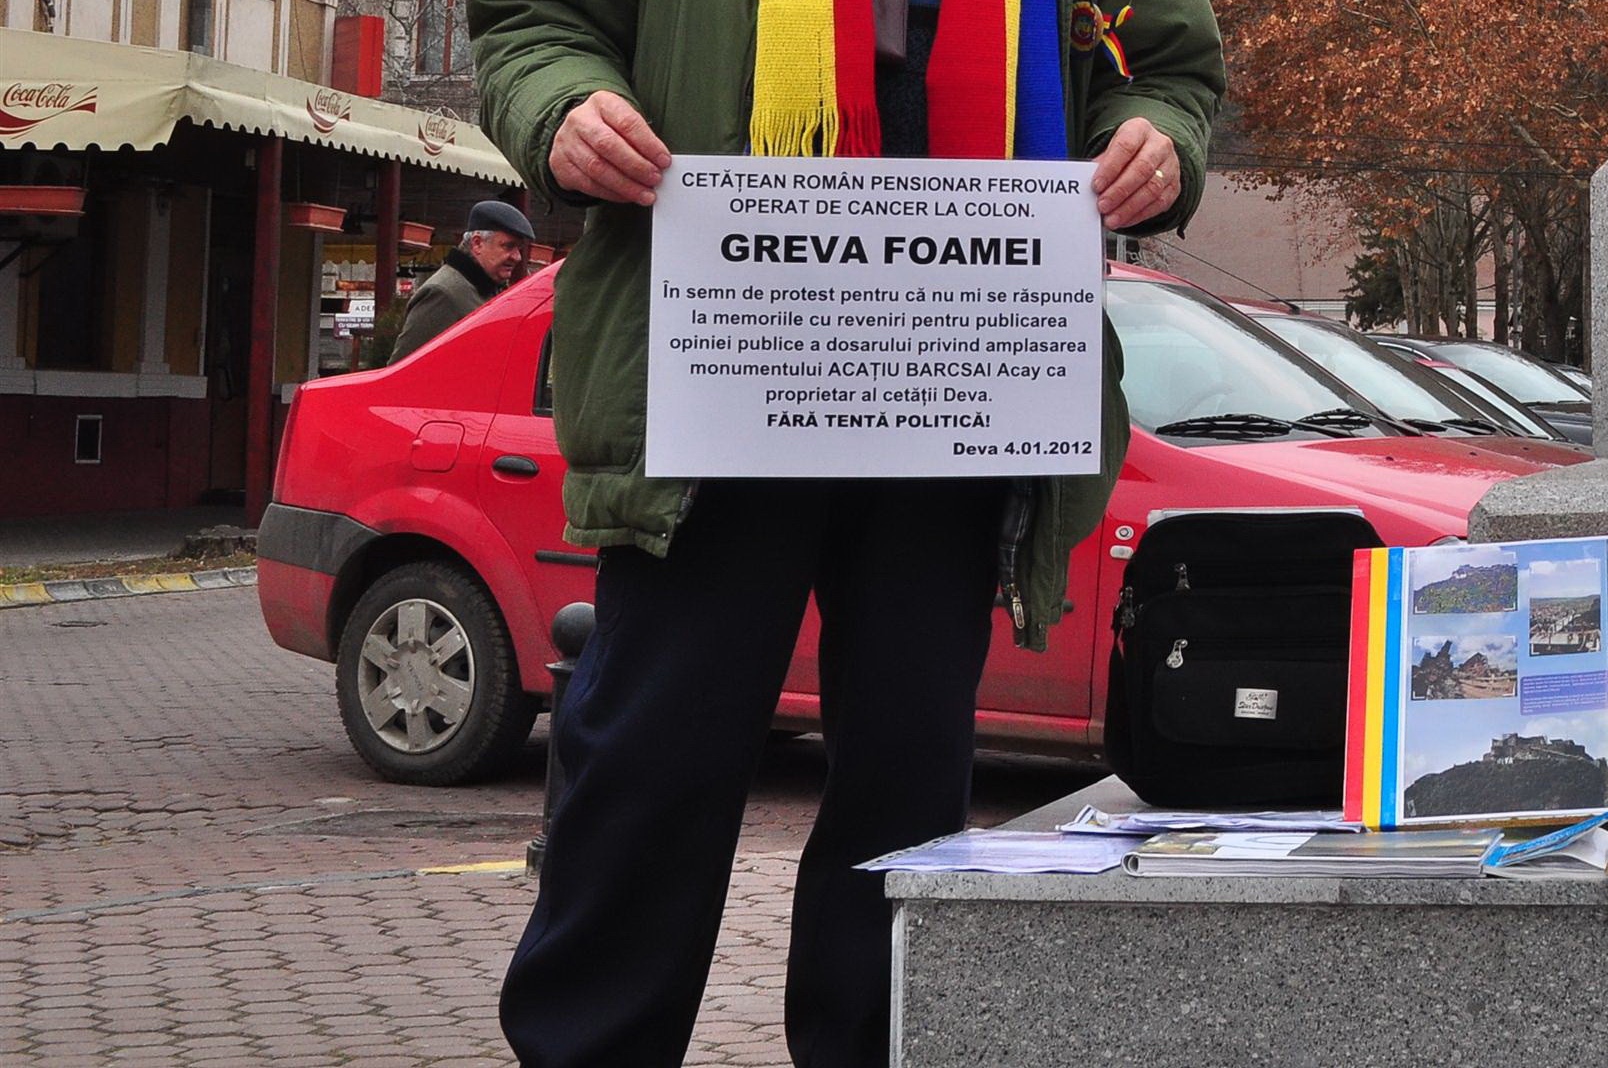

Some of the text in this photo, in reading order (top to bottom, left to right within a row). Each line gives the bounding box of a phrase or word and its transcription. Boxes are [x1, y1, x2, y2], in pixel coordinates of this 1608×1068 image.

[794, 172, 864, 189] ROMÂN
[872, 176, 981, 192] PENSIONAR
[988, 178, 1079, 194] FEROVIAR
[730, 199, 1034, 217] OPERAT DE CANCER LA COLON.
[721, 234, 1040, 265] GREVA FOAMEI
[664, 280, 1094, 306] În semn de protest pentru că nu mi se răspunde
[692, 310, 1067, 330] la memoriile cu reveniri pentru publicarea
[670, 335, 1086, 355] opiniei publice a dosarului privind amplasarea
[691, 362, 822, 376] monumentului
[907, 363, 990, 377] BARCSAI
[997, 363, 1040, 380] Acay
[1047, 366, 1066, 377] ca
[766, 387, 856, 404] proprietar
[862, 388, 876, 401] al
[944, 388, 992, 401] Deva.
[768, 411, 990, 427] FĂRĂ TENTĂ POLITICĂ!
[954, 442, 1091, 455] Deva 4.01.2012
